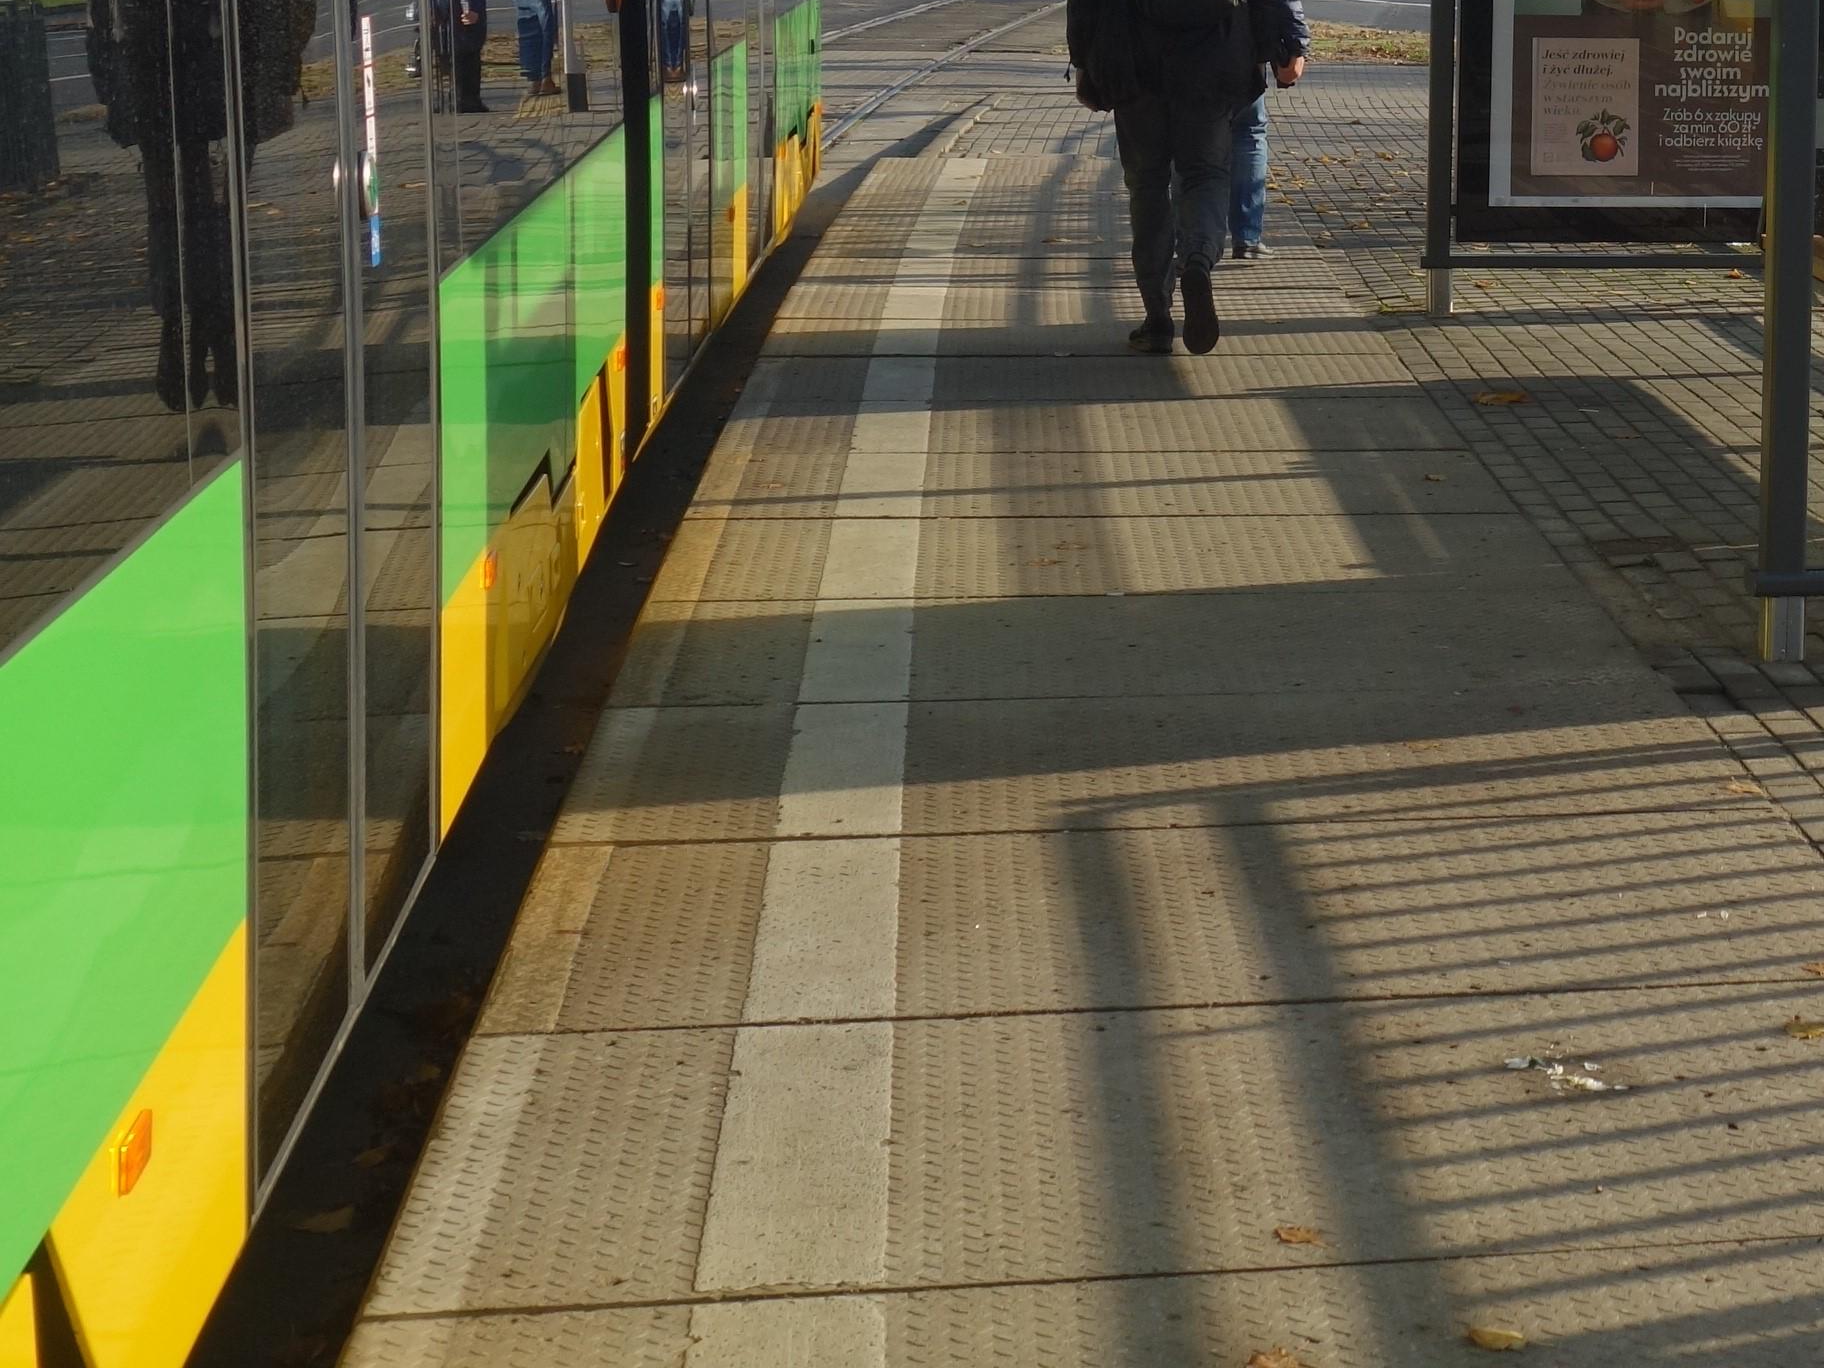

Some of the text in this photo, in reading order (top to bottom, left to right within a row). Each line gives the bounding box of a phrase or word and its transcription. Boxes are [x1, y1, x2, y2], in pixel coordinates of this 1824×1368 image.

[1673, 26, 1753, 49] Podaruj
[1571, 48, 1625, 62] zdrowiej
[1673, 44, 1753, 63] zdrowie
[1679, 62, 1741, 80] swoim
[1654, 79, 1770, 103] najbliższym
[1662, 108, 1761, 124] Zrób 6 x zakupy
[1673, 124, 1688, 133] za
[1690, 121, 1717, 133] min.
[1718, 121, 1740, 133] 60
[1664, 134, 1716, 147] odbierz
[1717, 134, 1764, 151] książkę
